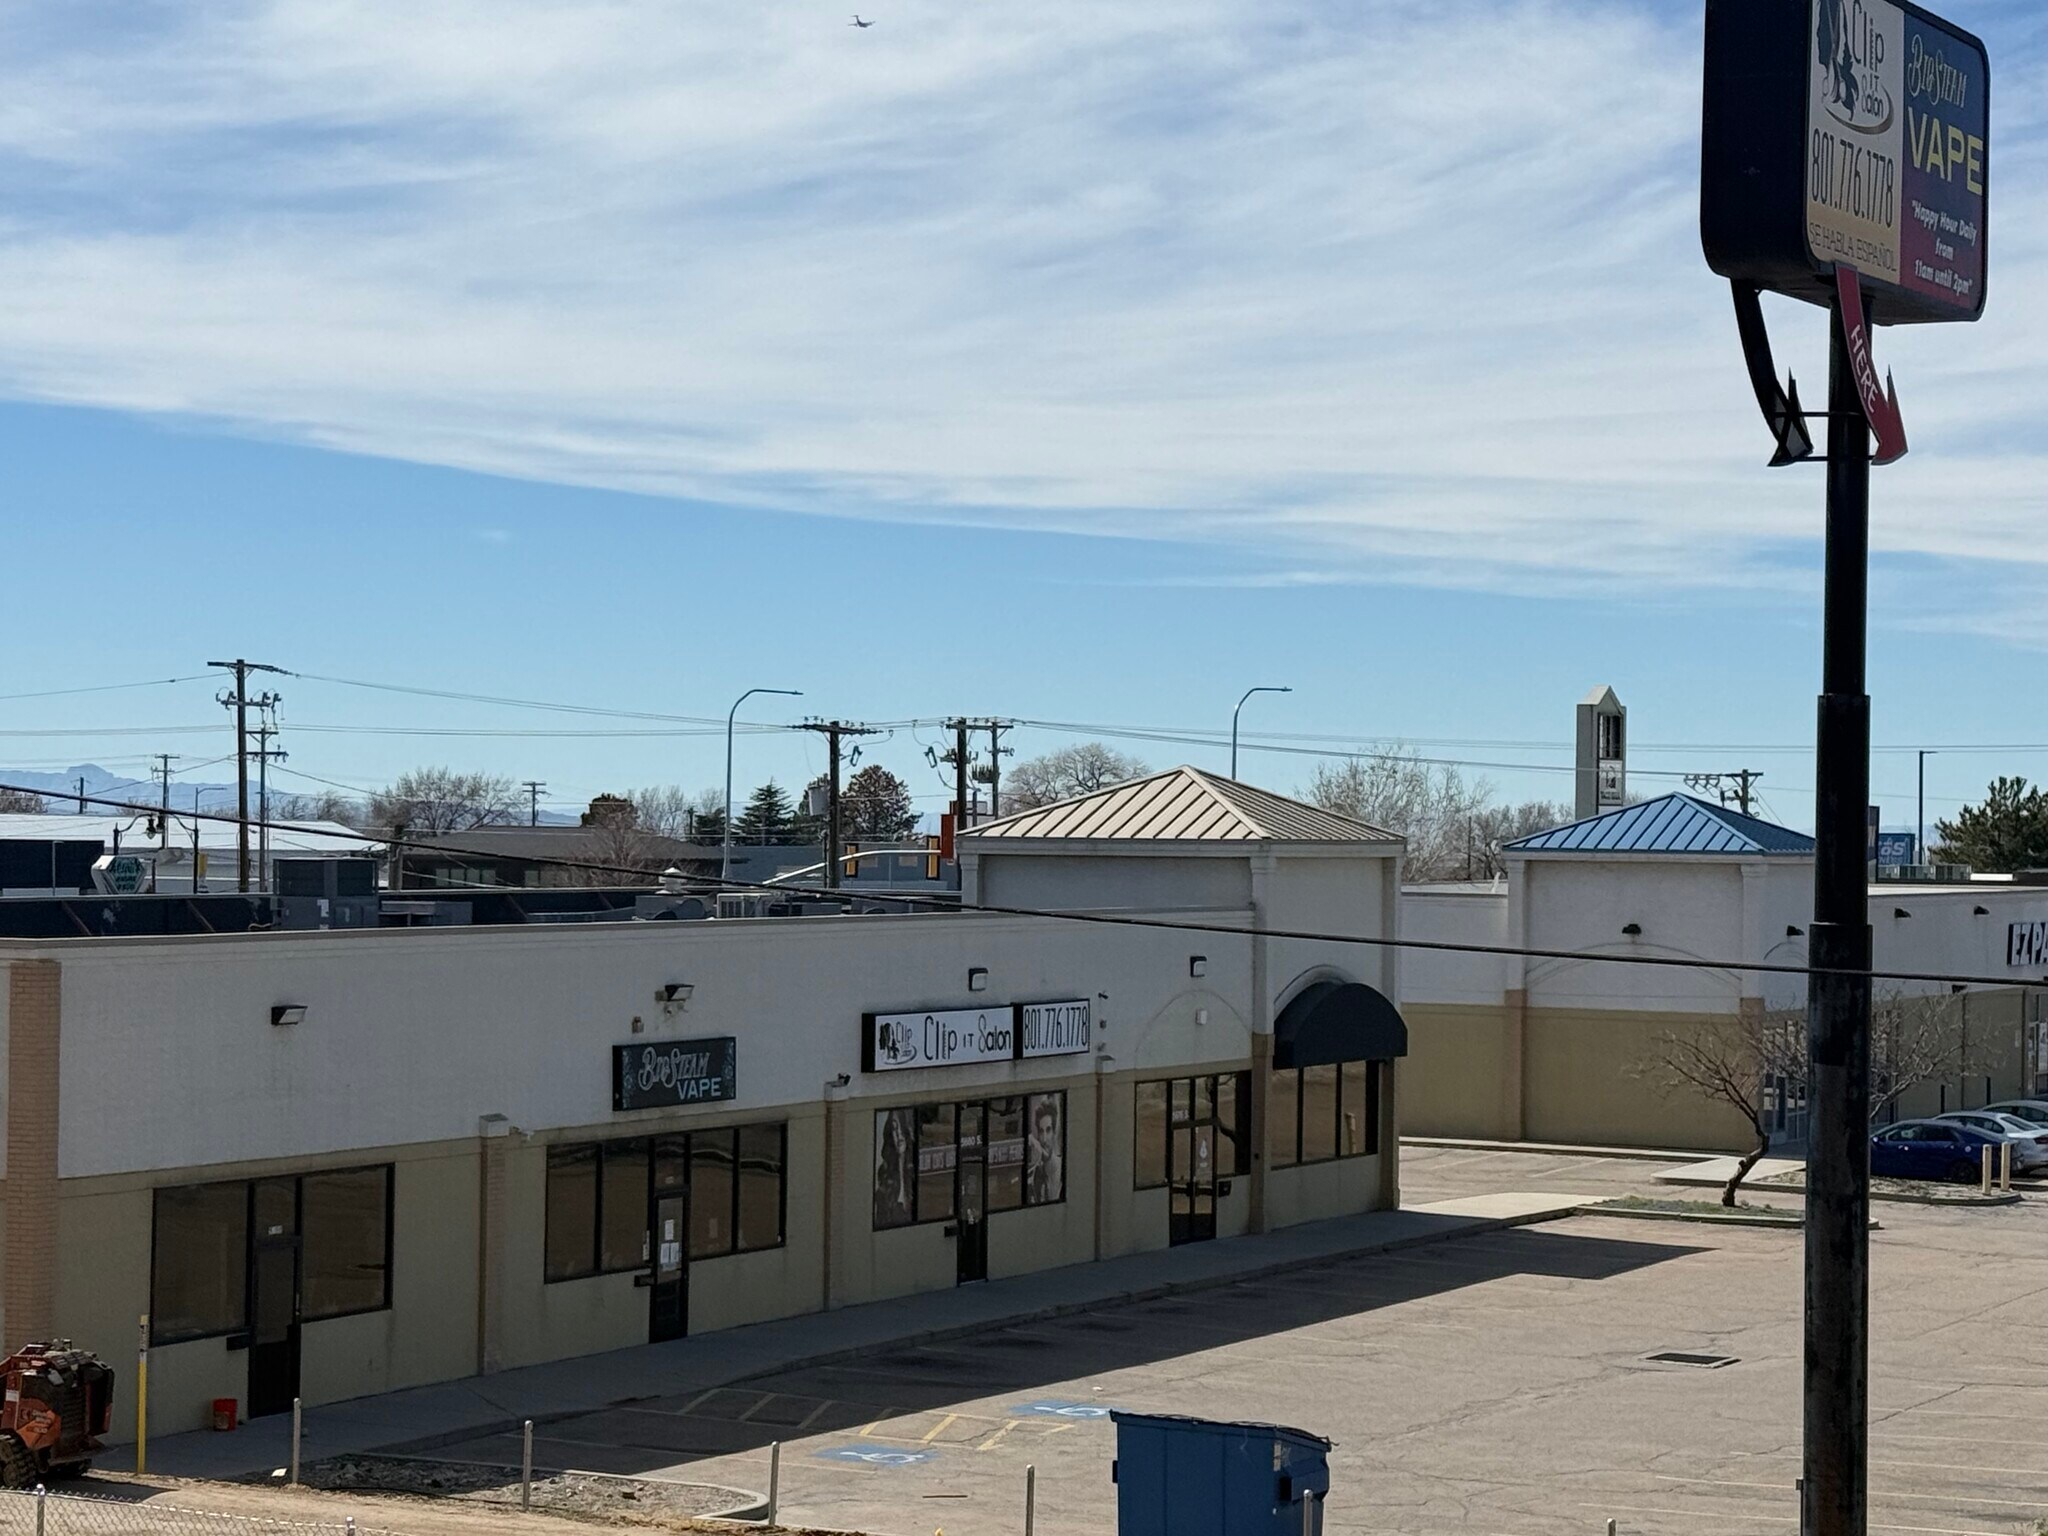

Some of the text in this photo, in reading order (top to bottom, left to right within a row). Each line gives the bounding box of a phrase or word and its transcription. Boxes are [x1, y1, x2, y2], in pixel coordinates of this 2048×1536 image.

[1852, 0, 1885, 73] Clip
[1908, 106, 1984, 196] VAPE
[1811, 127, 1894, 228] 801.776.1778
[1809, 222, 1821, 247] SE
[1822, 227, 1855, 258] HABLA
[1935, 237, 1954, 261] from
[1940, 211, 1958, 234] Hour
[1959, 219, 1977, 247] Daily
[1935, 268, 1953, 288] until
[1851, 324, 1879, 413] HERE
[924, 1015, 958, 1061] Clip
[978, 1014, 1012, 1054] Salon
[1024, 1006, 1089, 1051] 801.776.1778
[677, 1077, 722, 1100] VAPE
